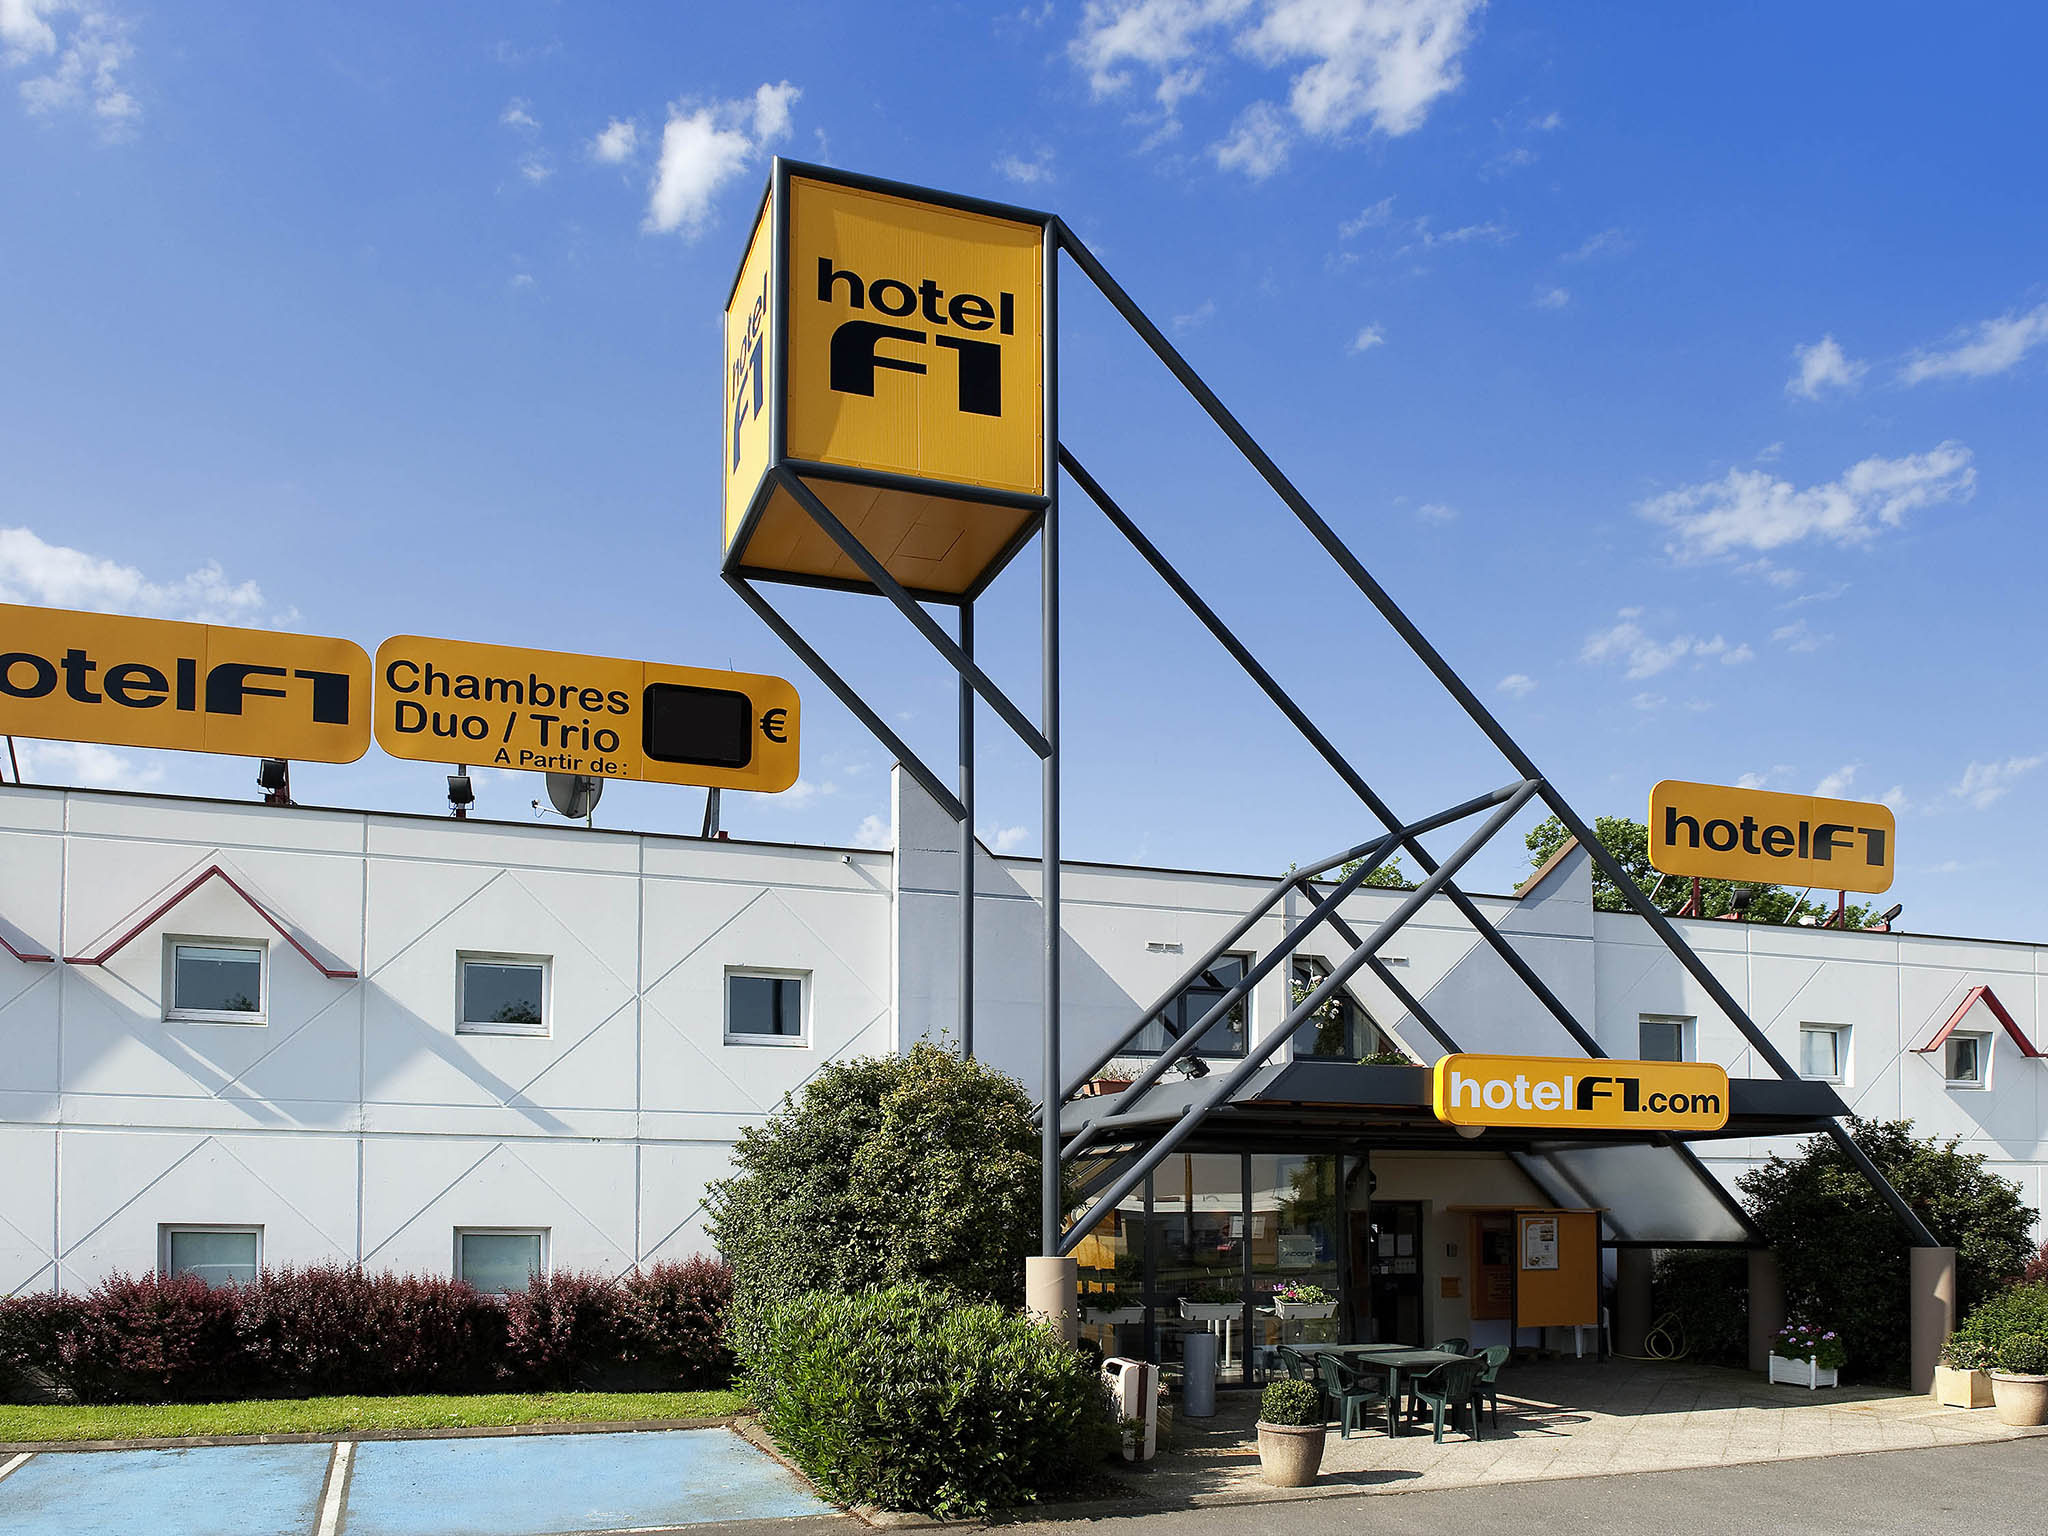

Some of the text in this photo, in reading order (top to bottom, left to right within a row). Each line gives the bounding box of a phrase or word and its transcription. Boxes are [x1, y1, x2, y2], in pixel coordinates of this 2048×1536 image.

[817, 256, 1015, 336] hotel
[829, 319, 1002, 418] F1
[733, 330, 764, 476] F1
[386, 659, 631, 716] Chambres
[395, 700, 620, 754] Duo / Trio
[760, 708, 788, 744] €
[494, 747, 511, 765] A
[519, 749, 583, 771] Partir
